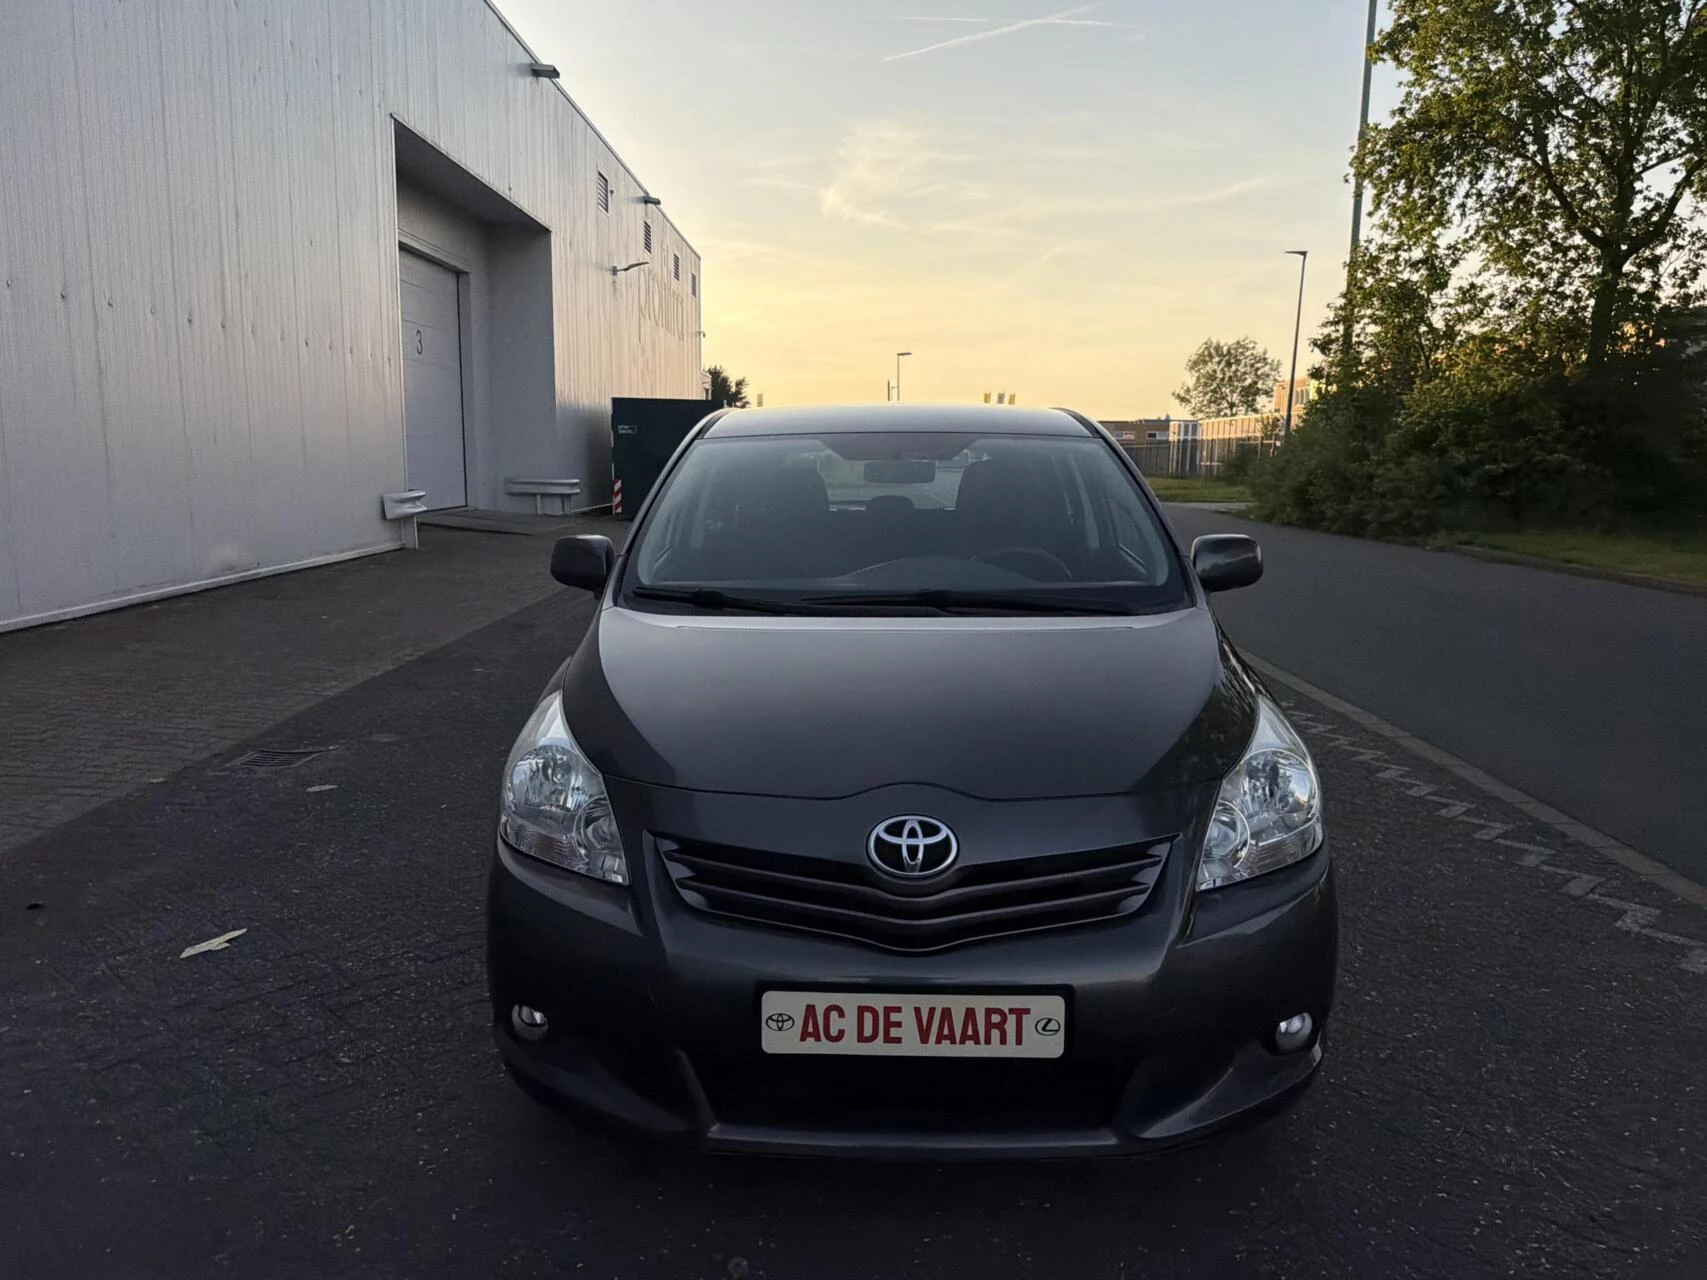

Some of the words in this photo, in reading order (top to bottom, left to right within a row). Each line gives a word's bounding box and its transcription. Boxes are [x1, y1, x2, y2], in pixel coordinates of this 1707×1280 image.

[415, 329, 423, 356] 3
[799, 1004, 846, 1043] AC
[856, 1005, 903, 1044] DE
[913, 1006, 1031, 1046] VAART
